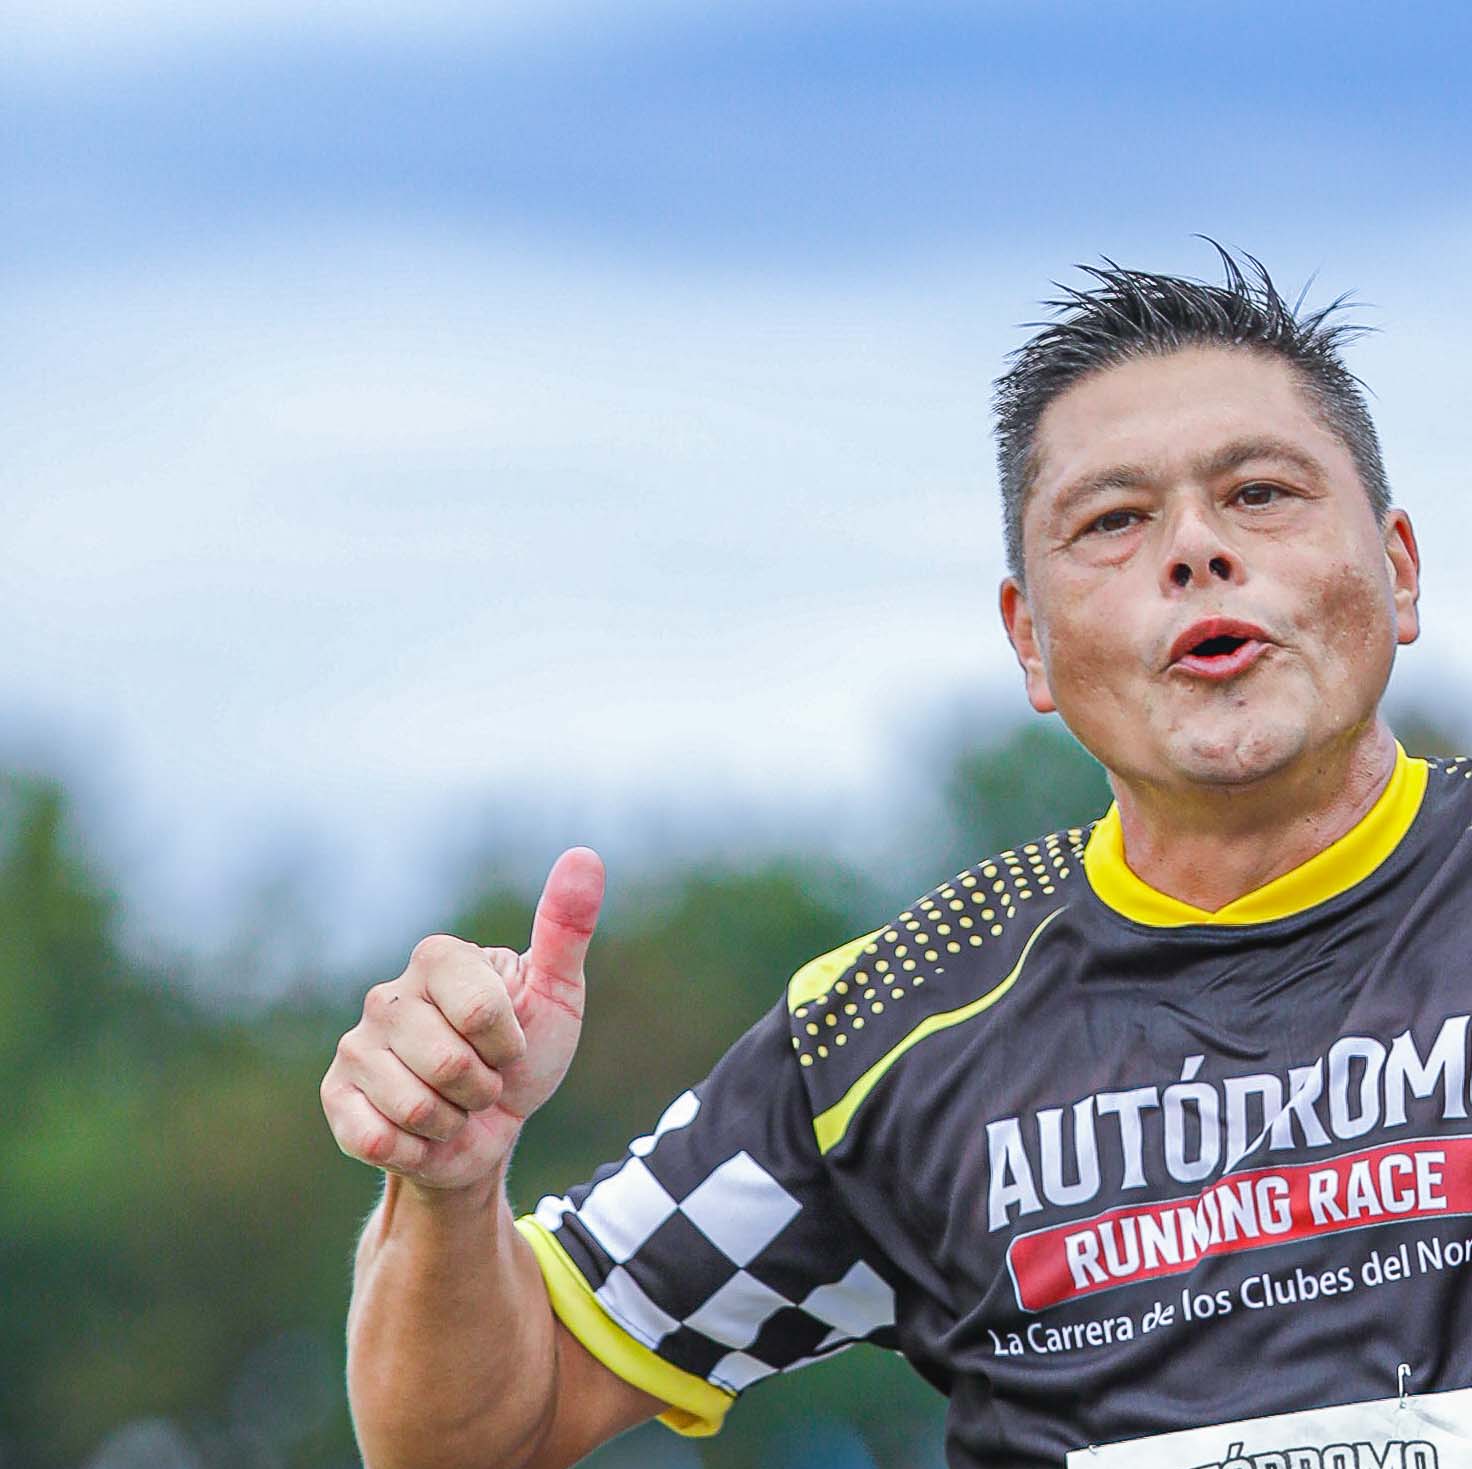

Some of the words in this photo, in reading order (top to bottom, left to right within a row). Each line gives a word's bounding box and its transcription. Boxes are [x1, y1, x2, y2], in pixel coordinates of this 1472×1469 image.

[1063, 1176, 1293, 1290] RUNNING
[1308, 1150, 1449, 1227] RACE
[987, 1329, 1025, 1356] La
[1027, 1315, 1134, 1354] Carrera
[1142, 1304, 1174, 1334] de
[1183, 1288, 1232, 1321] los
[1240, 1268, 1354, 1310] Clubes
[1362, 1244, 1411, 1287] del
